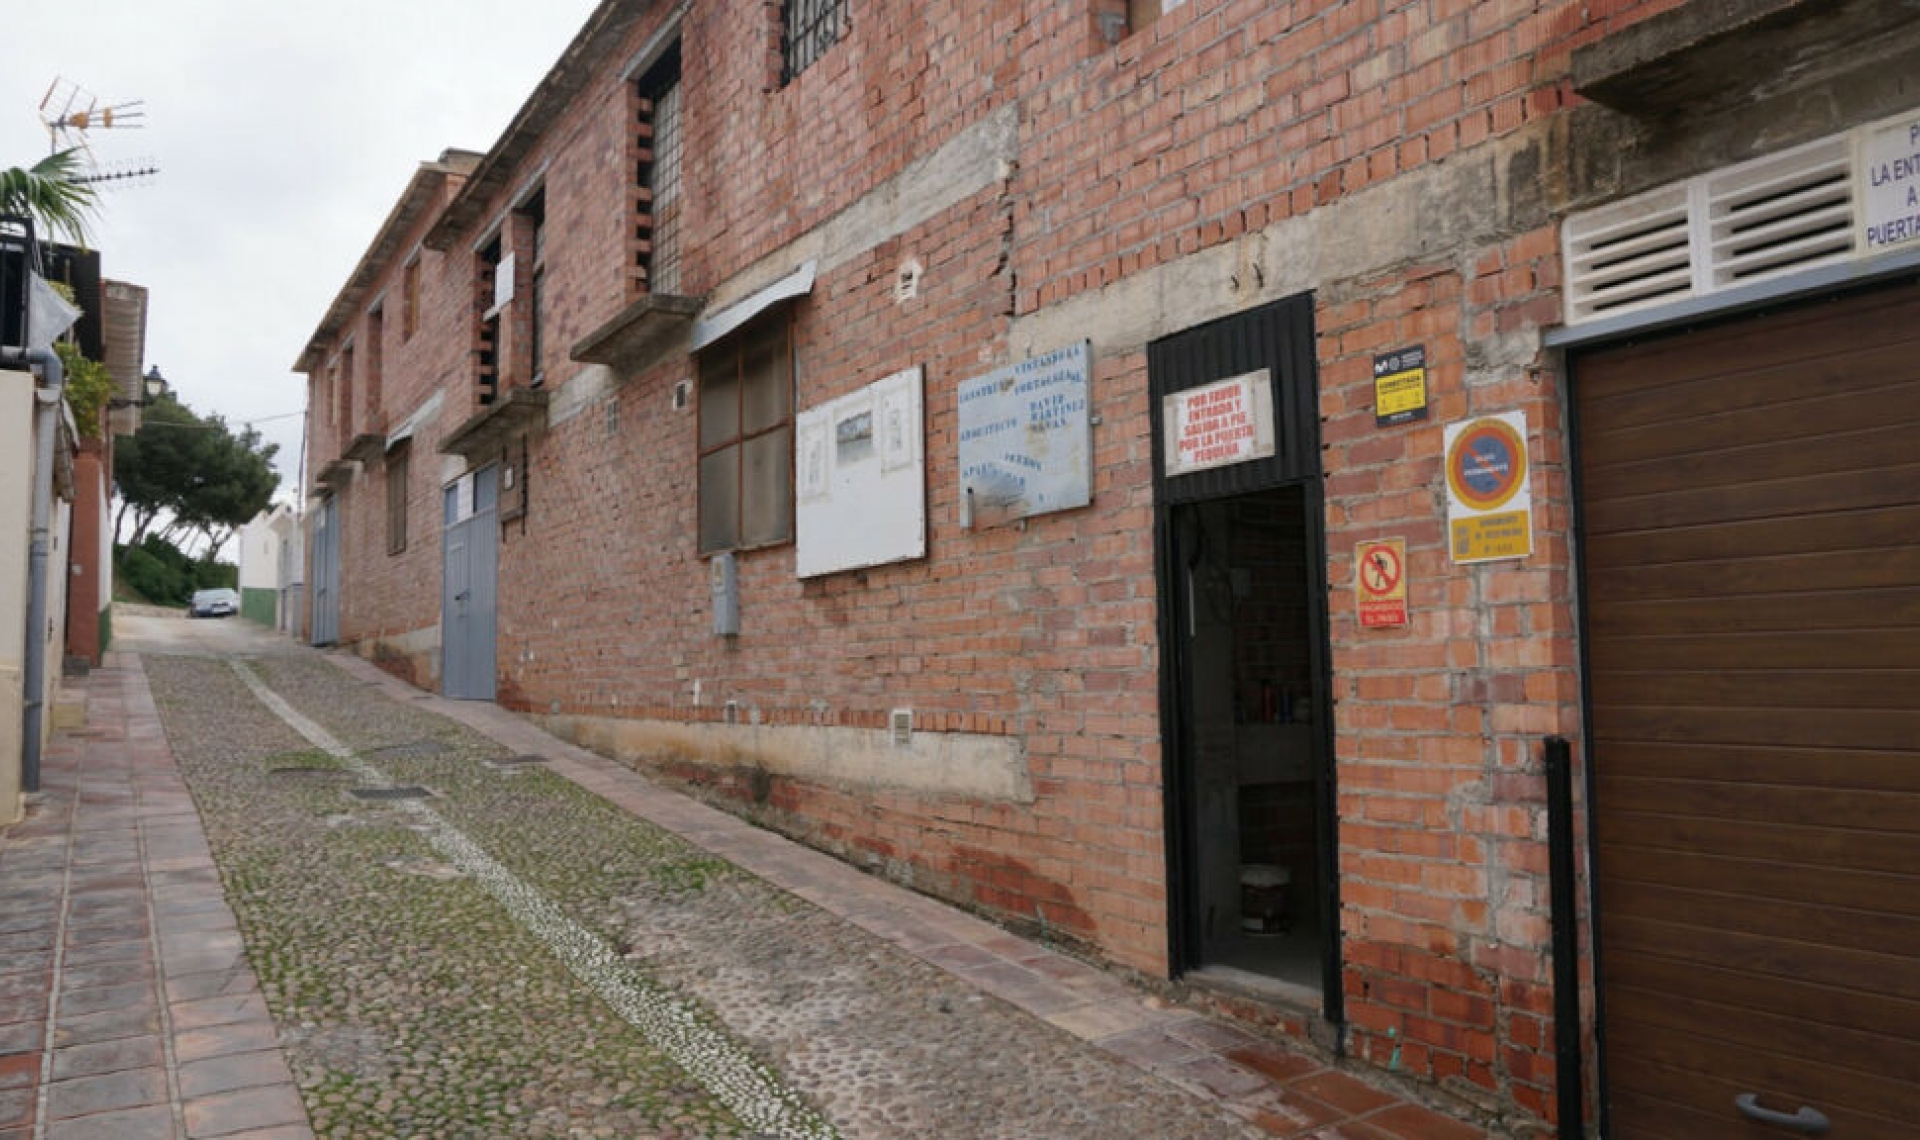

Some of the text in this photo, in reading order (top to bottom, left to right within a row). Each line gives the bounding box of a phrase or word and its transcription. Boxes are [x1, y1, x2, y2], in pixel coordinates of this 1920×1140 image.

[1871, 164, 1891, 187] LA
[1187, 384, 1241, 409] POR FAVOR
[1189, 399, 1241, 421] ENTRADA Y
[1178, 438, 1198, 450] POR
[1215, 424, 1254, 443] PUERTA
